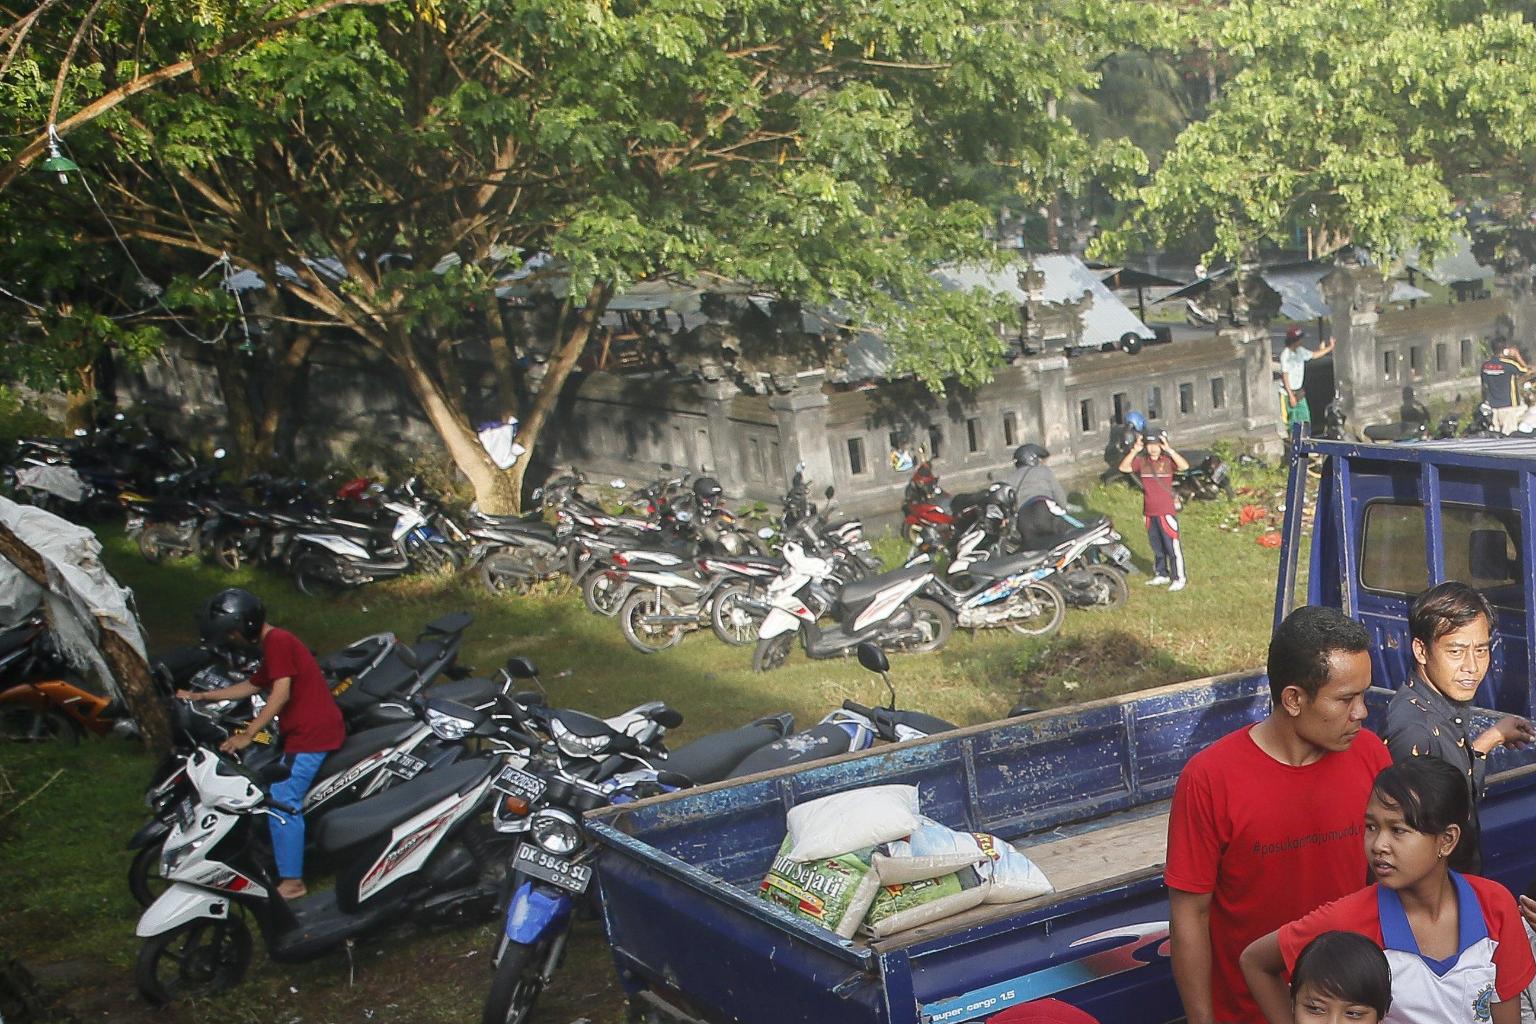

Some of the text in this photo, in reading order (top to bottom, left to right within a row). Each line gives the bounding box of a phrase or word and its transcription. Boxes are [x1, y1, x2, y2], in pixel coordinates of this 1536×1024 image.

[519, 846, 537, 862] DK
[792, 864, 844, 898] Sejati
[932, 1006, 963, 1022] super
[966, 997, 997, 1012] cargo
